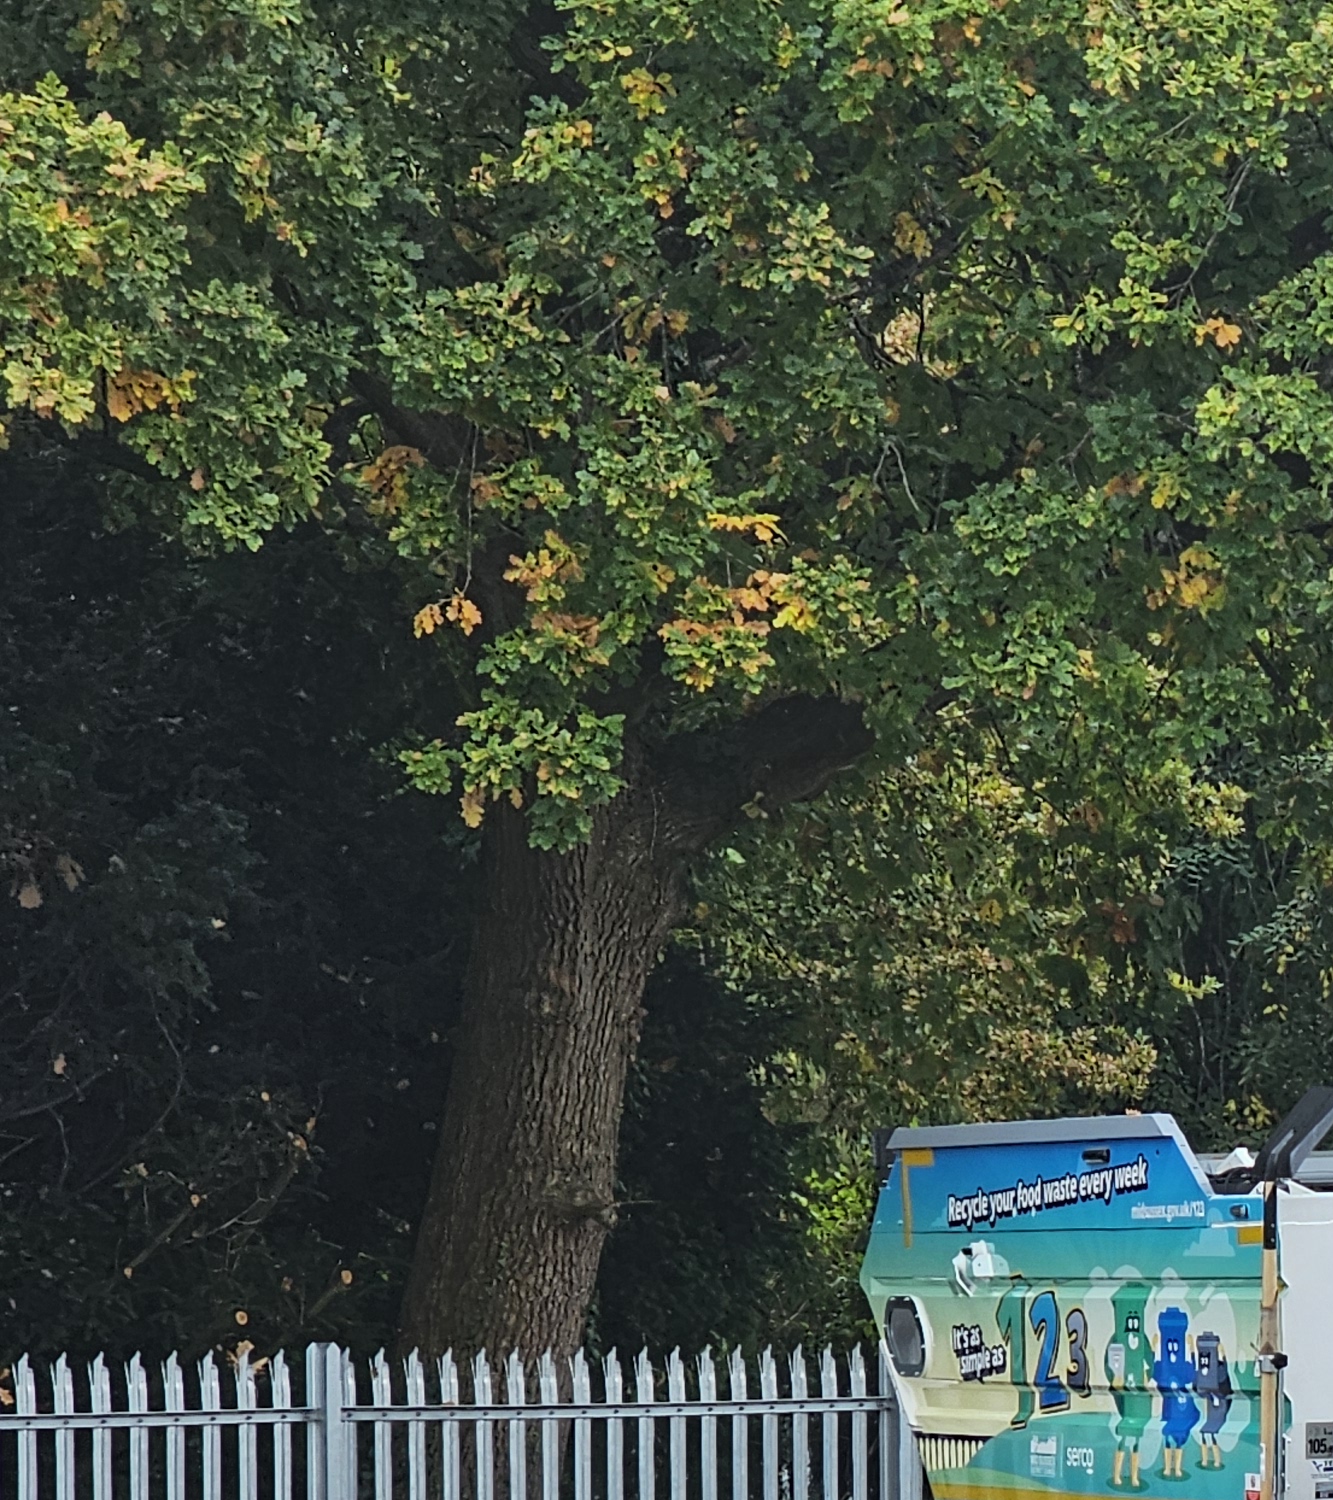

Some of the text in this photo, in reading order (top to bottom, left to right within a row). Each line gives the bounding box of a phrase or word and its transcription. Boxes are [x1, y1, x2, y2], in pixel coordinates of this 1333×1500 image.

[948, 1157, 1148, 1226] Recycle your food waste every week
[953, 1325, 981, 1350] It's as
[961, 1345, 1004, 1377] simple as
[1066, 1447, 1094, 1469] serco
[1308, 1438, 1327, 1454] 105
